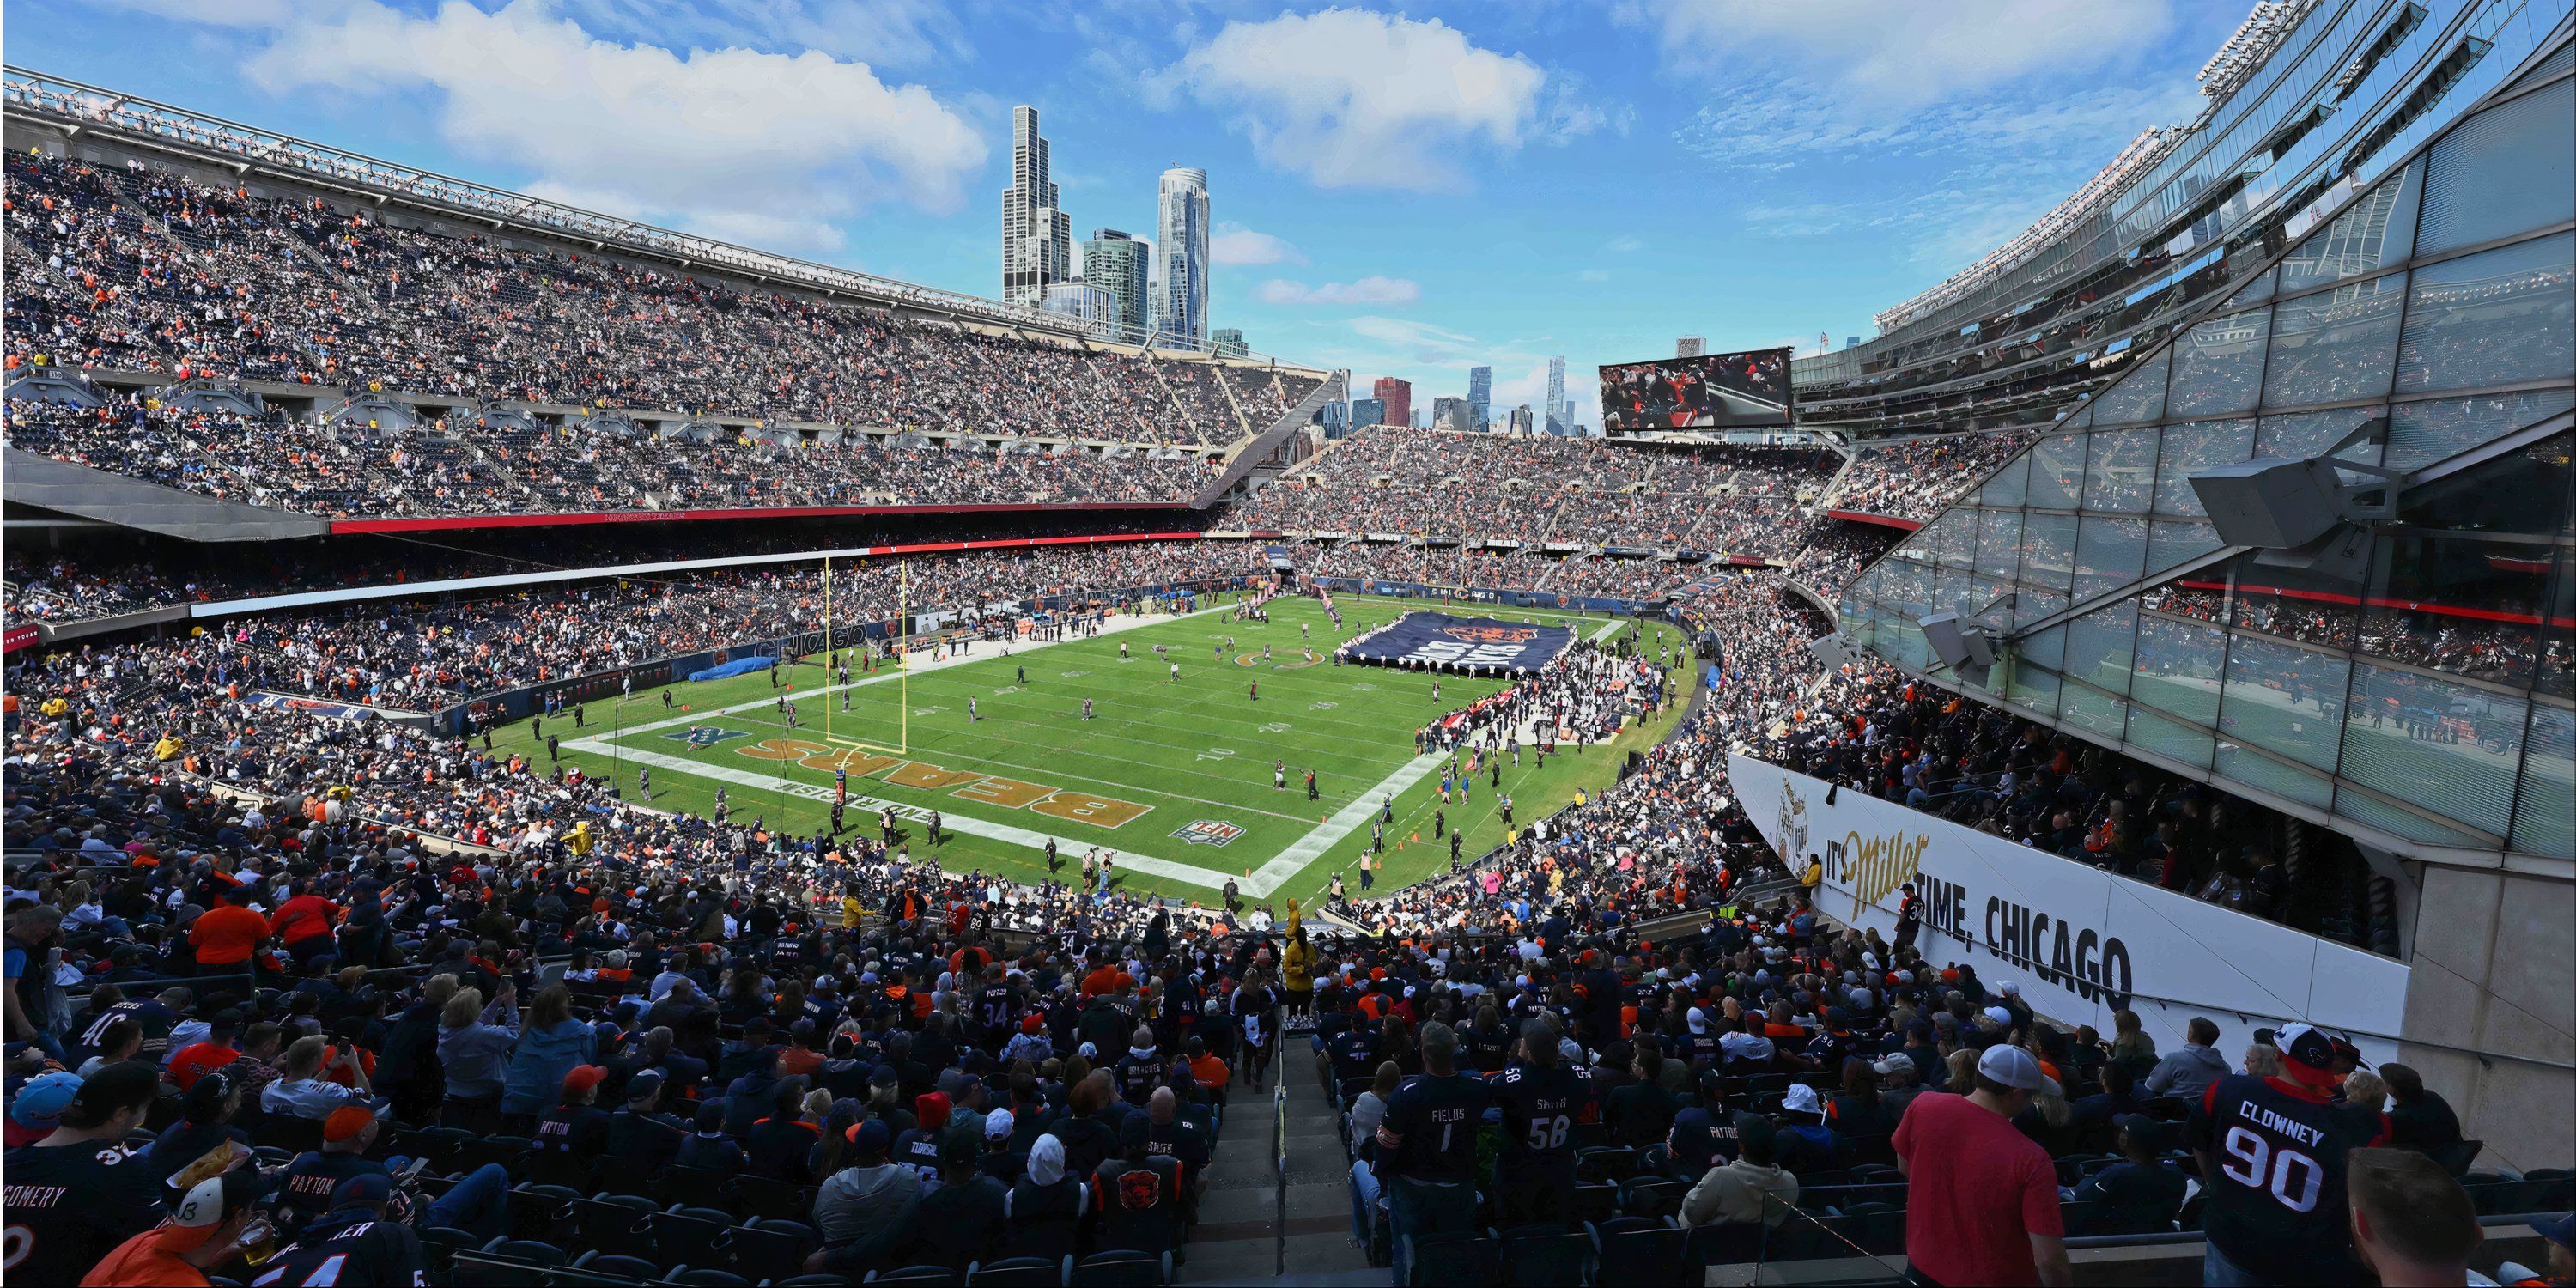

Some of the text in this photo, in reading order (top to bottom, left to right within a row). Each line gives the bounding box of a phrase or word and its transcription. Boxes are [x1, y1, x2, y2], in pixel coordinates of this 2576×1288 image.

[1196, 748, 1235, 761] 10
[734, 739, 1156, 829] BEARS
[775, 781, 880, 808] RACISM
[1844, 829, 1930, 923] Miller
[1914, 872, 1973, 953] TIME,
[1986, 896, 2132, 1013] CHICAGO
[1060, 934, 1075, 951] 54
[982, 1001, 1009, 1029] 34
[1821, 1036, 1835, 1048] 96
[1432, 1108, 1465, 1124] FIELDS
[2239, 1100, 2325, 1148] CLOWNEY
[1440, 1123, 1453, 1152] 1
[1527, 1115, 1571, 1150] 58
[2222, 1127, 2324, 1212] 90
[288, 1174, 337, 1195] PAYTON
